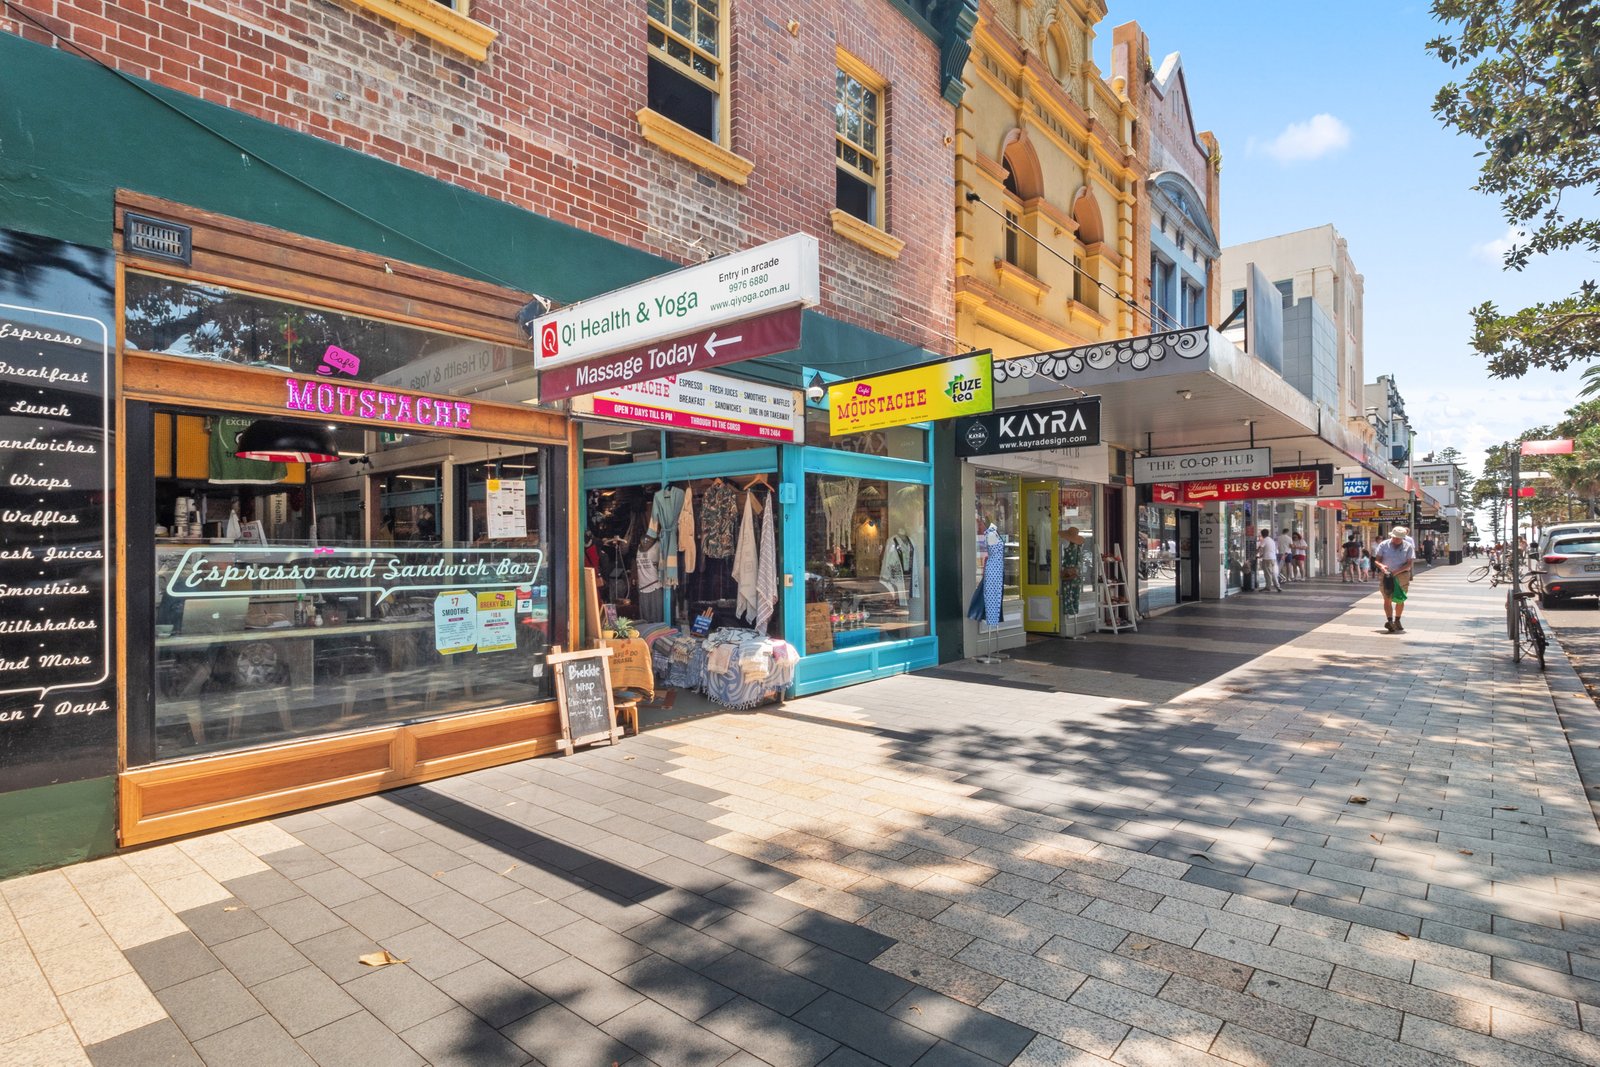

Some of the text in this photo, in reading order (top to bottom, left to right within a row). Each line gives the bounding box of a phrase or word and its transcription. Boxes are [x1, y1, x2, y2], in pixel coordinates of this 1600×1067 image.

[718, 257, 780, 283] Entry in arcade
[728, 274, 769, 293] 9976 6880
[710, 282, 790, 312] www.qiyoga.com.au
[561, 291, 698, 347] Qi Health & Yoga
[0, 323, 82, 345] Espresso
[329, 351, 356, 370] Café
[576, 343, 698, 387] Massage Today
[679, 378, 703, 391] ESPRESSO
[709, 384, 724, 395] FRESH
[724, 386, 738, 398] JUICES
[744, 391, 767, 404] SMOOTHIES
[773, 397, 790, 408] WAFFLES
[952, 378, 982, 394] FUZE
[286, 378, 471, 429] MOUSTACHE
[837, 389, 927, 420] MOUSTACHE
[952, 391, 973, 403] tea
[10, 400, 71, 417] Lunch
[614, 404, 673, 421] OPEN 7 DAYS TILL 5 PM
[678, 394, 790, 421] BREAKFAST SANDWICHES DINE IN OR TAKEAWAY
[690, 416, 741, 431] THROUGH TO THE CORSO
[1000, 408, 1087, 438] KAYRA
[0, 438, 96, 454] andwiches
[999, 435, 1087, 449] www.kayradesign.com
[1146, 454, 1254, 472] THE CO-OP HUB
[10, 473, 72, 490] Wraps
[1224, 482, 1249, 493] PIES
[1252, 481, 1261, 491] &
[1264, 478, 1310, 490] COFFEE
[2, 510, 79, 526] Waffles
[0, 547, 104, 562] esh Juices
[185, 557, 532, 588] Espresso and Sandwich Bar
[451, 597, 459, 607] $7
[442, 607, 470, 616] SMOOTHIE
[39, 654, 92, 668] More
[33, 703, 45, 719] 7
[54, 699, 110, 717] Days
